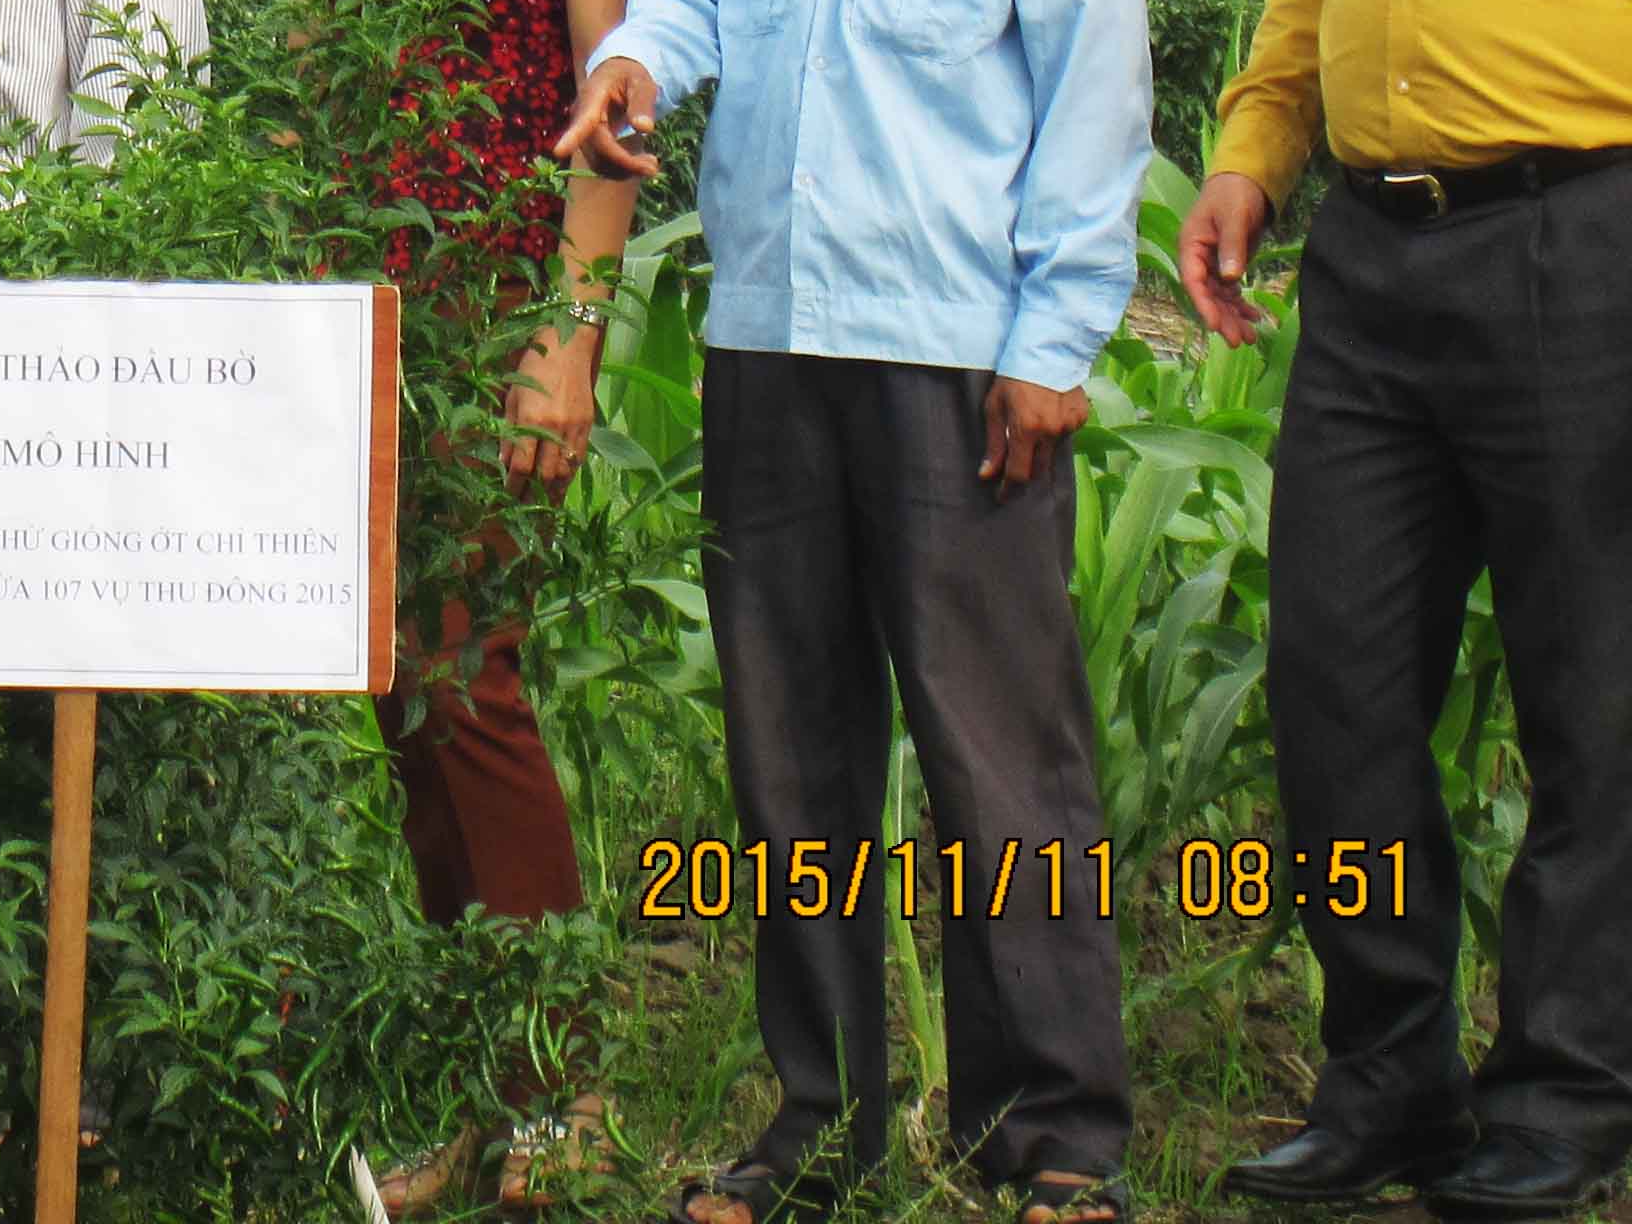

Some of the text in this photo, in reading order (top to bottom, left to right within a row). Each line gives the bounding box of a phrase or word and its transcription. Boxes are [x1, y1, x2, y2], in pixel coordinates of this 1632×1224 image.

[206, 348, 257, 386] BỜ
[1, 430, 169, 469] MÔ HÌNH
[253, 527, 338, 555] THIÊN
[42, 579, 82, 601] 107
[91, 579, 130, 606] VỤ
[138, 580, 198, 603] THU
[206, 575, 288, 605] ĐÔNG
[295, 582, 353, 605] 2015
